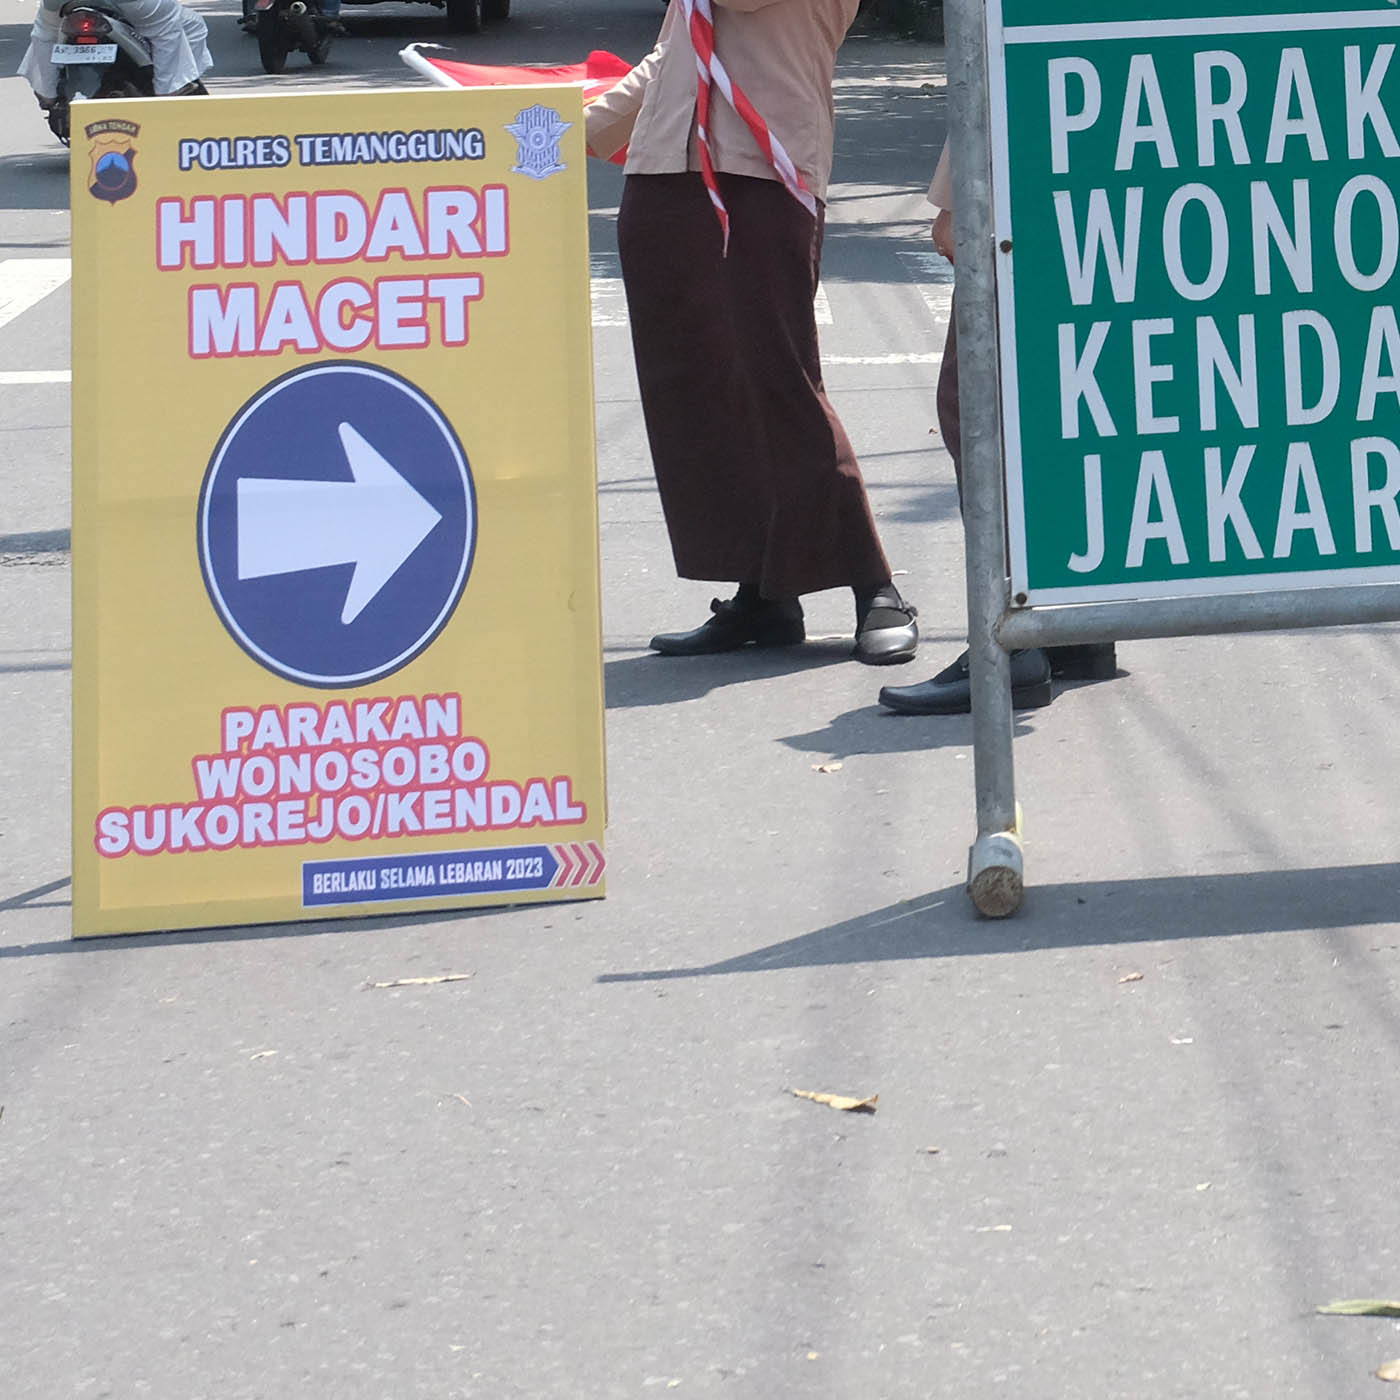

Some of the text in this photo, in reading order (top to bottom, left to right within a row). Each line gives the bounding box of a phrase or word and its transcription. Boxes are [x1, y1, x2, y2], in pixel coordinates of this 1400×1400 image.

[179, 129, 485, 171] POLRES TEMANGGUNG
[157, 185, 509, 271] HINDARI
[189, 275, 482, 357] MACET
[222, 694, 460, 753] PARAKAN
[195, 739, 488, 800] WONOSOBO
[97, 777, 586, 857] SUKOREJO/KENDAL
[312, 856, 543, 895] BERLAKU SELAMA LEBARAN 2023
